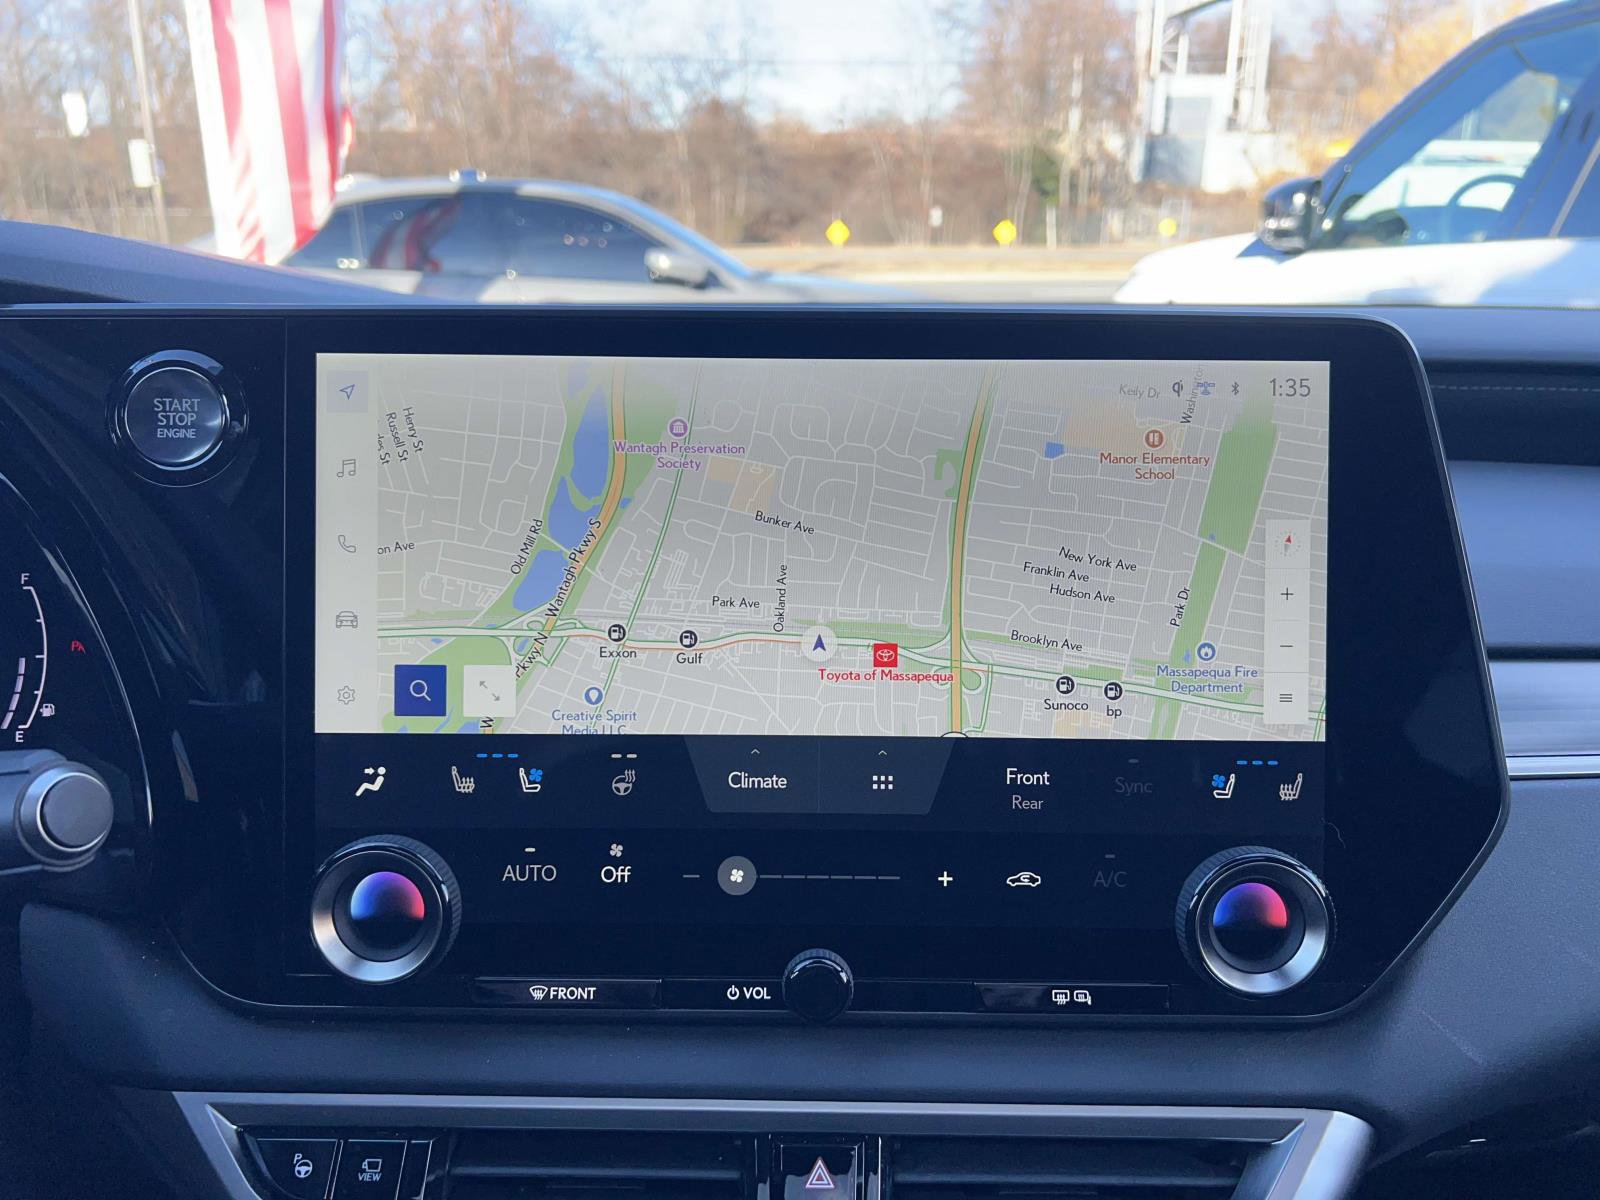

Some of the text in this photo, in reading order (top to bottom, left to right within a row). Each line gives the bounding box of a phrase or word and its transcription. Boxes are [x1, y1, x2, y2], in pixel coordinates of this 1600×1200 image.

[1147, 387, 1161, 400] Dr
[1269, 378, 1312, 397] 1:35
[153, 398, 200, 412] START
[157, 412, 197, 426] STOP
[156, 427, 197, 439] ENGINE
[402, 406, 424, 453] Henry St
[385, 412, 409, 463] Russell St
[614, 441, 745, 455] Wantagh Preservation
[379, 452, 390, 465] St
[657, 457, 701, 471] Society
[1100, 452, 1210, 467] Manor Elementary
[1135, 467, 1175, 480] School
[755, 510, 815, 535] Bunker Ave
[393, 541, 415, 552] Ave
[510, 519, 544, 575] Old Mill Rd
[1058, 546, 1137, 572] New York Ave
[545, 518, 602, 618] Wantagh Pkwy S
[1023, 561, 1090, 583] Franklin Ave
[20, 572, 30, 584] F
[773, 564, 788, 632] Oakland Ave
[1049, 584, 1116, 604] Hudson Ave
[712, 596, 760, 609] Park Ave
[1169, 586, 1191, 628] Park Dr
[533, 631, 549, 646] N
[1010, 629, 1083, 652] Brooklyn Ave
[599, 647, 637, 659] Exxon
[676, 652, 703, 665] Gulf
[818, 668, 954, 685] Toyota of Massapequa
[1156, 665, 1258, 681] Massapequa Fire
[1171, 681, 1244, 696] Department
[1043, 698, 1089, 711] Sunoco
[1106, 704, 1122, 720] bp
[551, 709, 637, 723] Creative Spirit
[15, 731, 24, 743] E
[562, 724, 599, 735] Media
[728, 771, 788, 789] Climate
[1005, 768, 1050, 785] Front
[1115, 776, 1152, 797] Sync
[1012, 795, 1044, 810] Rear
[502, 864, 557, 882] AUTO
[600, 865, 632, 884] Off
[1092, 870, 1128, 888] A/C
[549, 986, 597, 1000] FRONT
[742, 987, 771, 1000] VOL
[358, 1173, 383, 1181] VIEW
